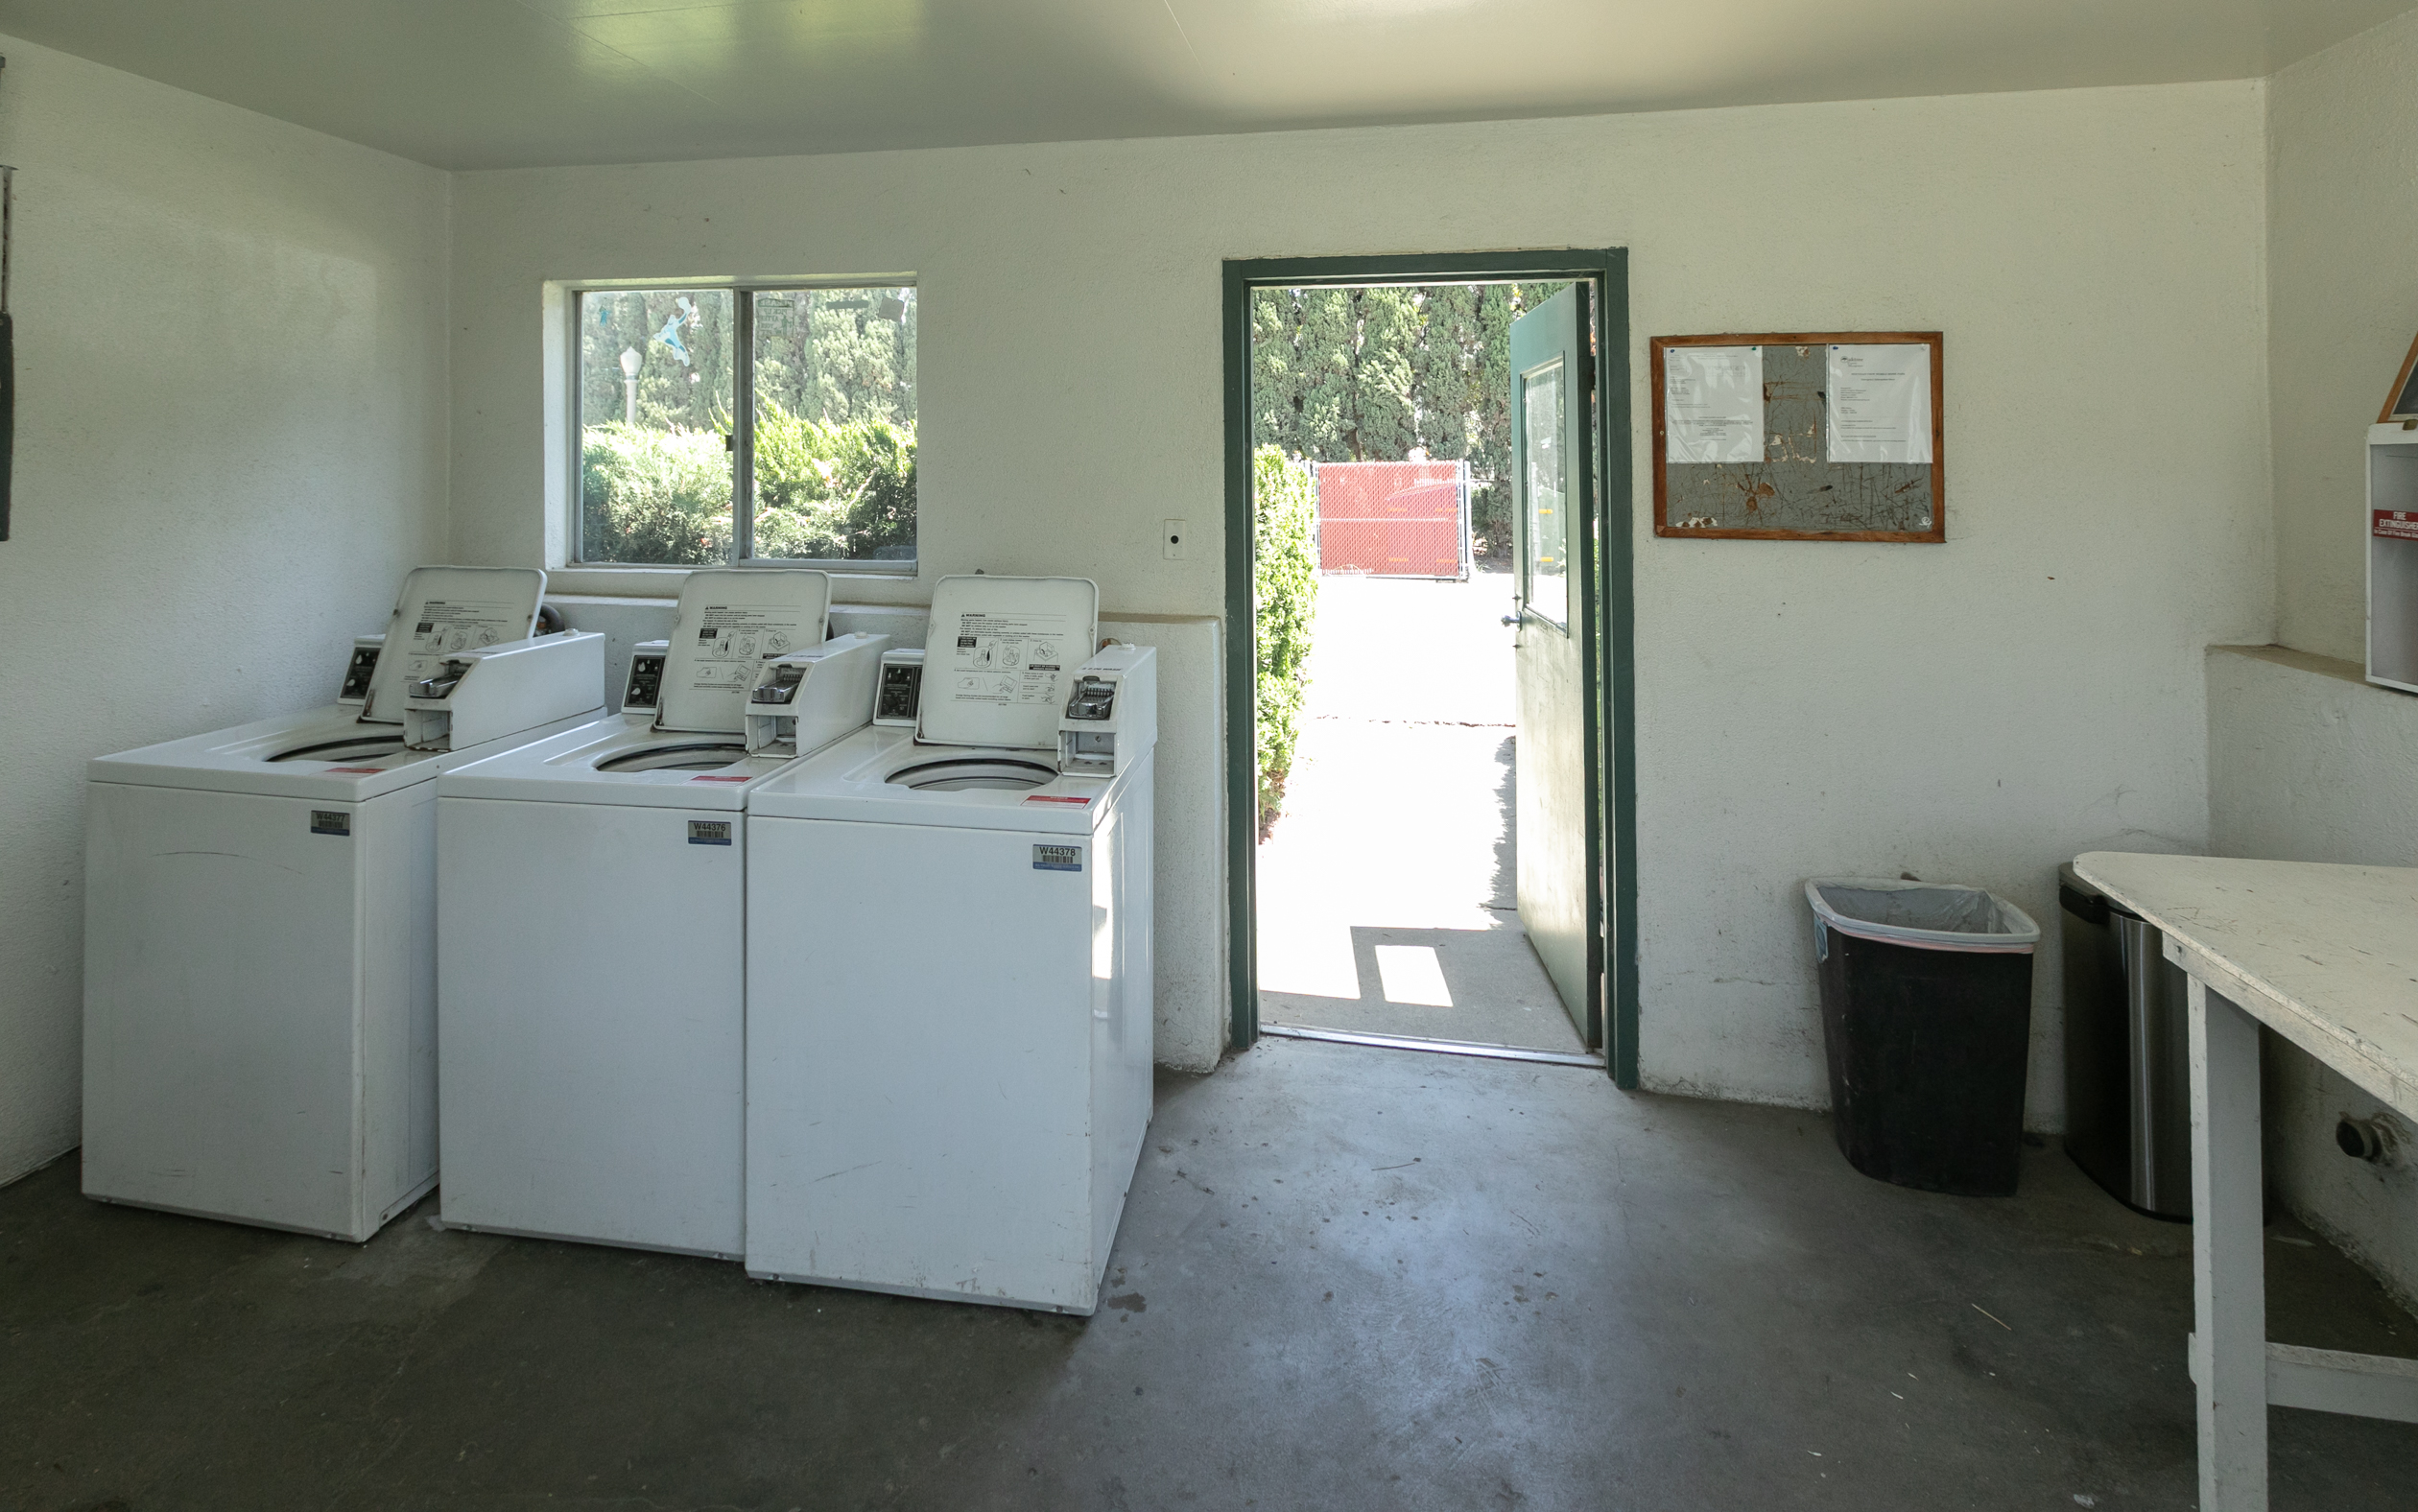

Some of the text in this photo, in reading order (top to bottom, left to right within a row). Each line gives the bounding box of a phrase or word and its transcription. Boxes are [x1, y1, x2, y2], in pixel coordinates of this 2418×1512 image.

[2393, 511, 2406, 520] FIRE
[316, 813, 345, 822] W44377
[694, 822, 726, 832] W44376
[1039, 846, 1076, 857] W44378
